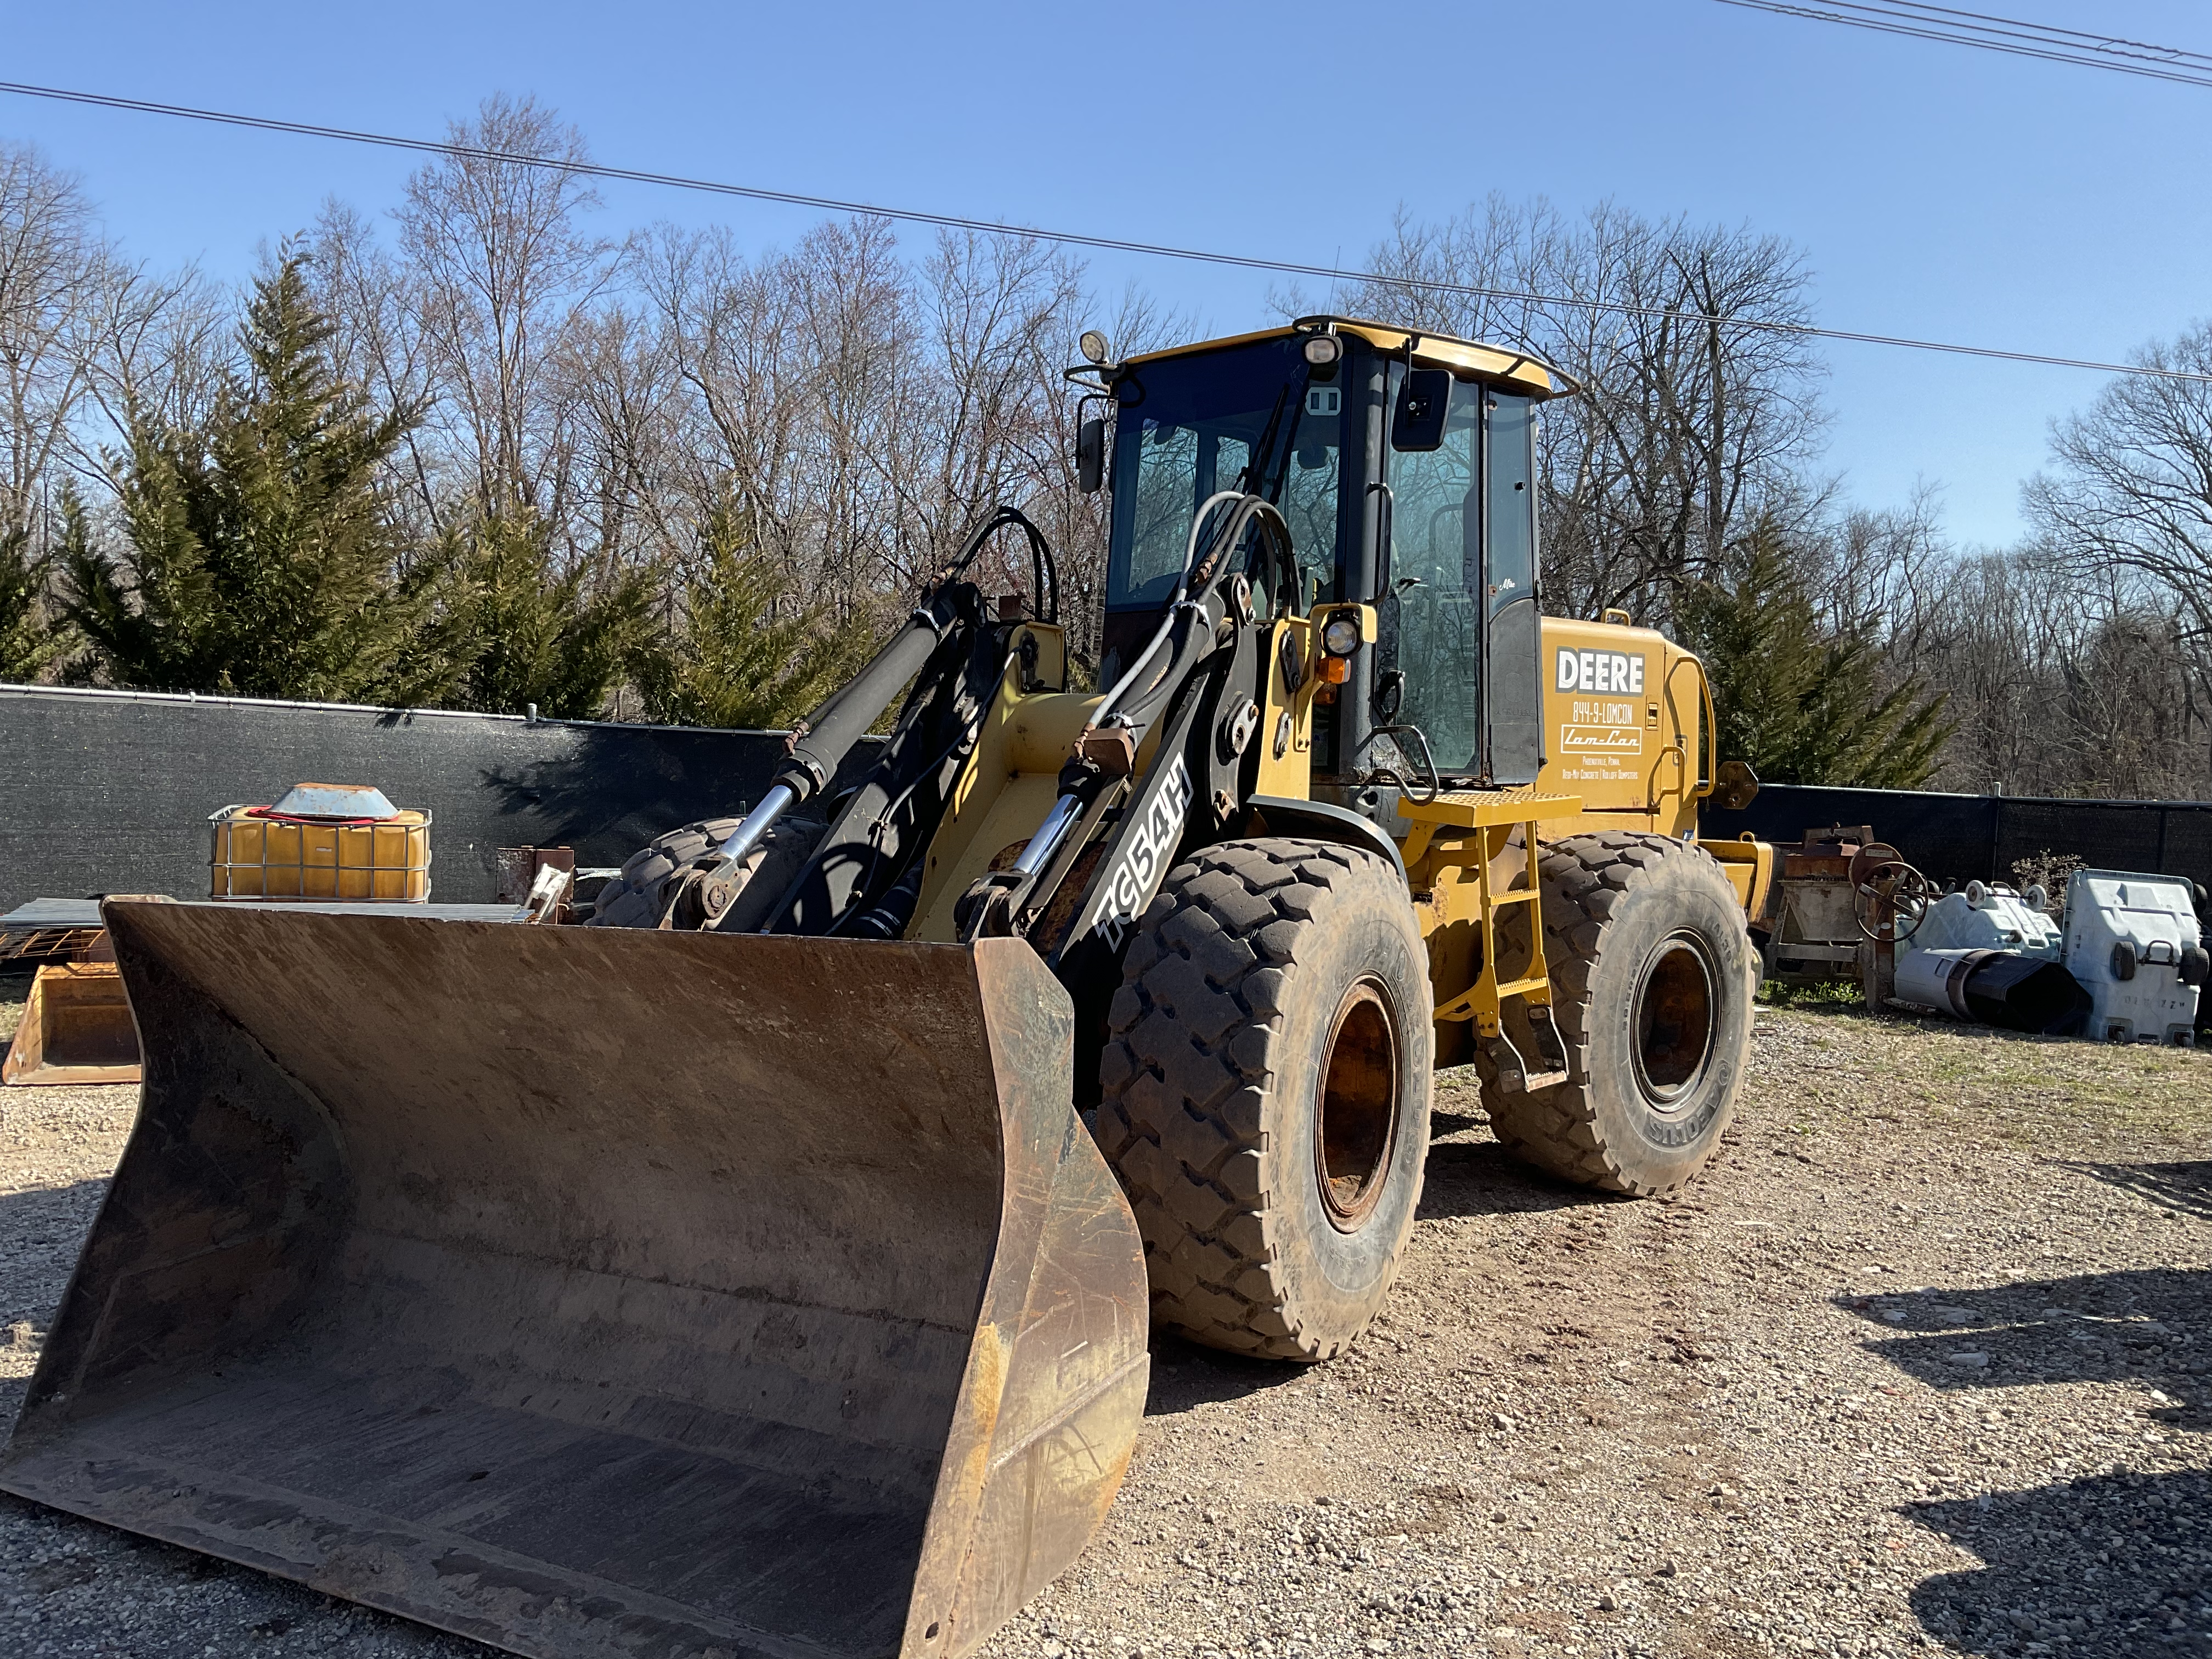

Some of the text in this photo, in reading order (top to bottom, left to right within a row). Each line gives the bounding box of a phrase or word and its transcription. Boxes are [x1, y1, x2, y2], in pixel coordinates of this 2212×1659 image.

[1499, 578, 1515, 591] Mike
[1558, 651, 1643, 693] DEERE
[1573, 701, 1633, 725] 844-9-LOMCON
[1091, 751, 1194, 955] TC54H
[1647, 1082, 1722, 1146] AEOLUS
